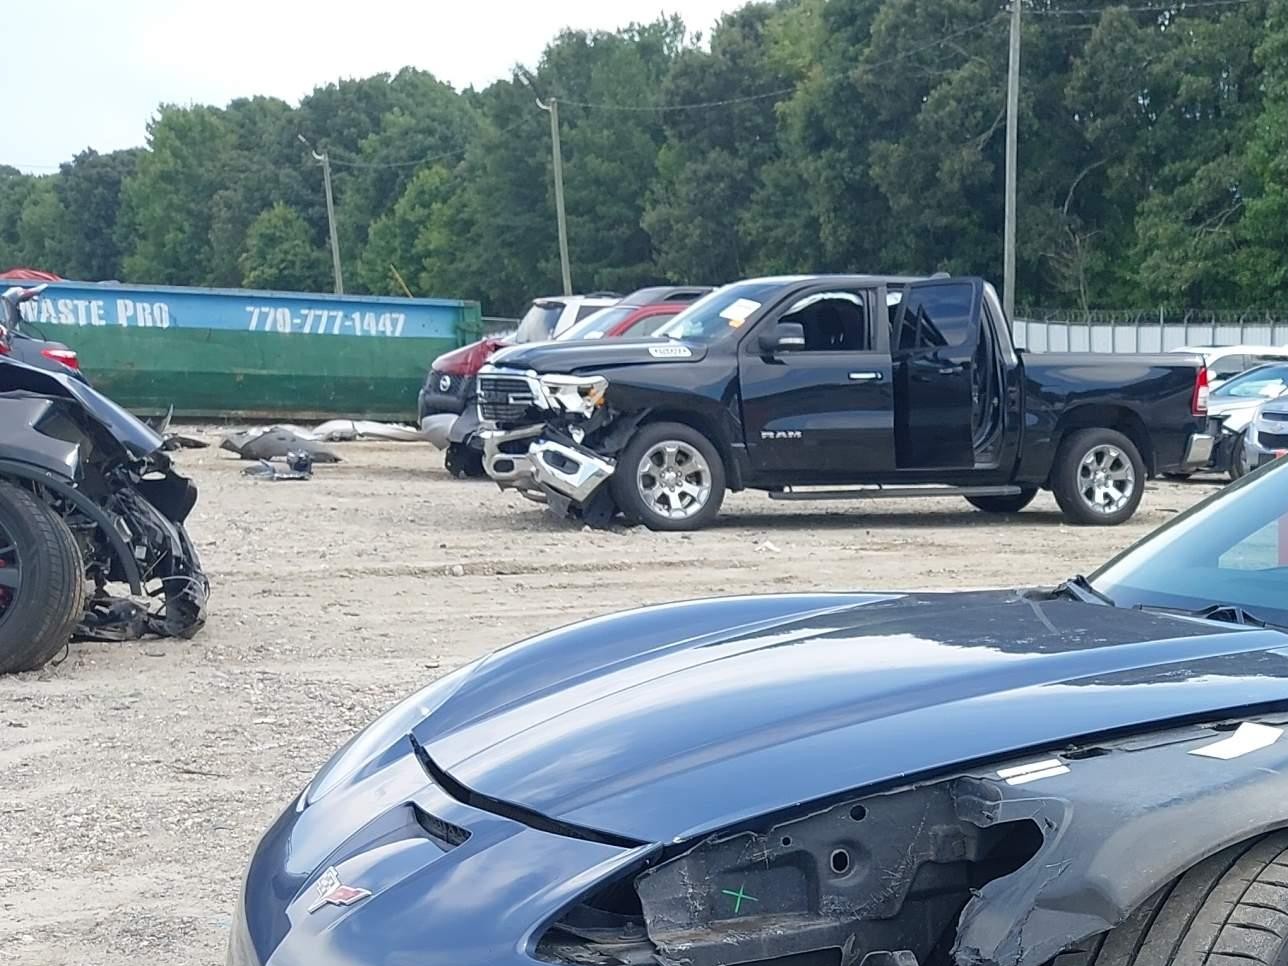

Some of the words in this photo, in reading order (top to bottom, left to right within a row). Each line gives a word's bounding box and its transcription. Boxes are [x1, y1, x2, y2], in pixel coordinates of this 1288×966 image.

[19, 298, 106, 326] WASTE
[117, 299, 170, 329] PRO
[246, 306, 406, 337] 770-777-1447
[760, 430, 802, 440] RAM
